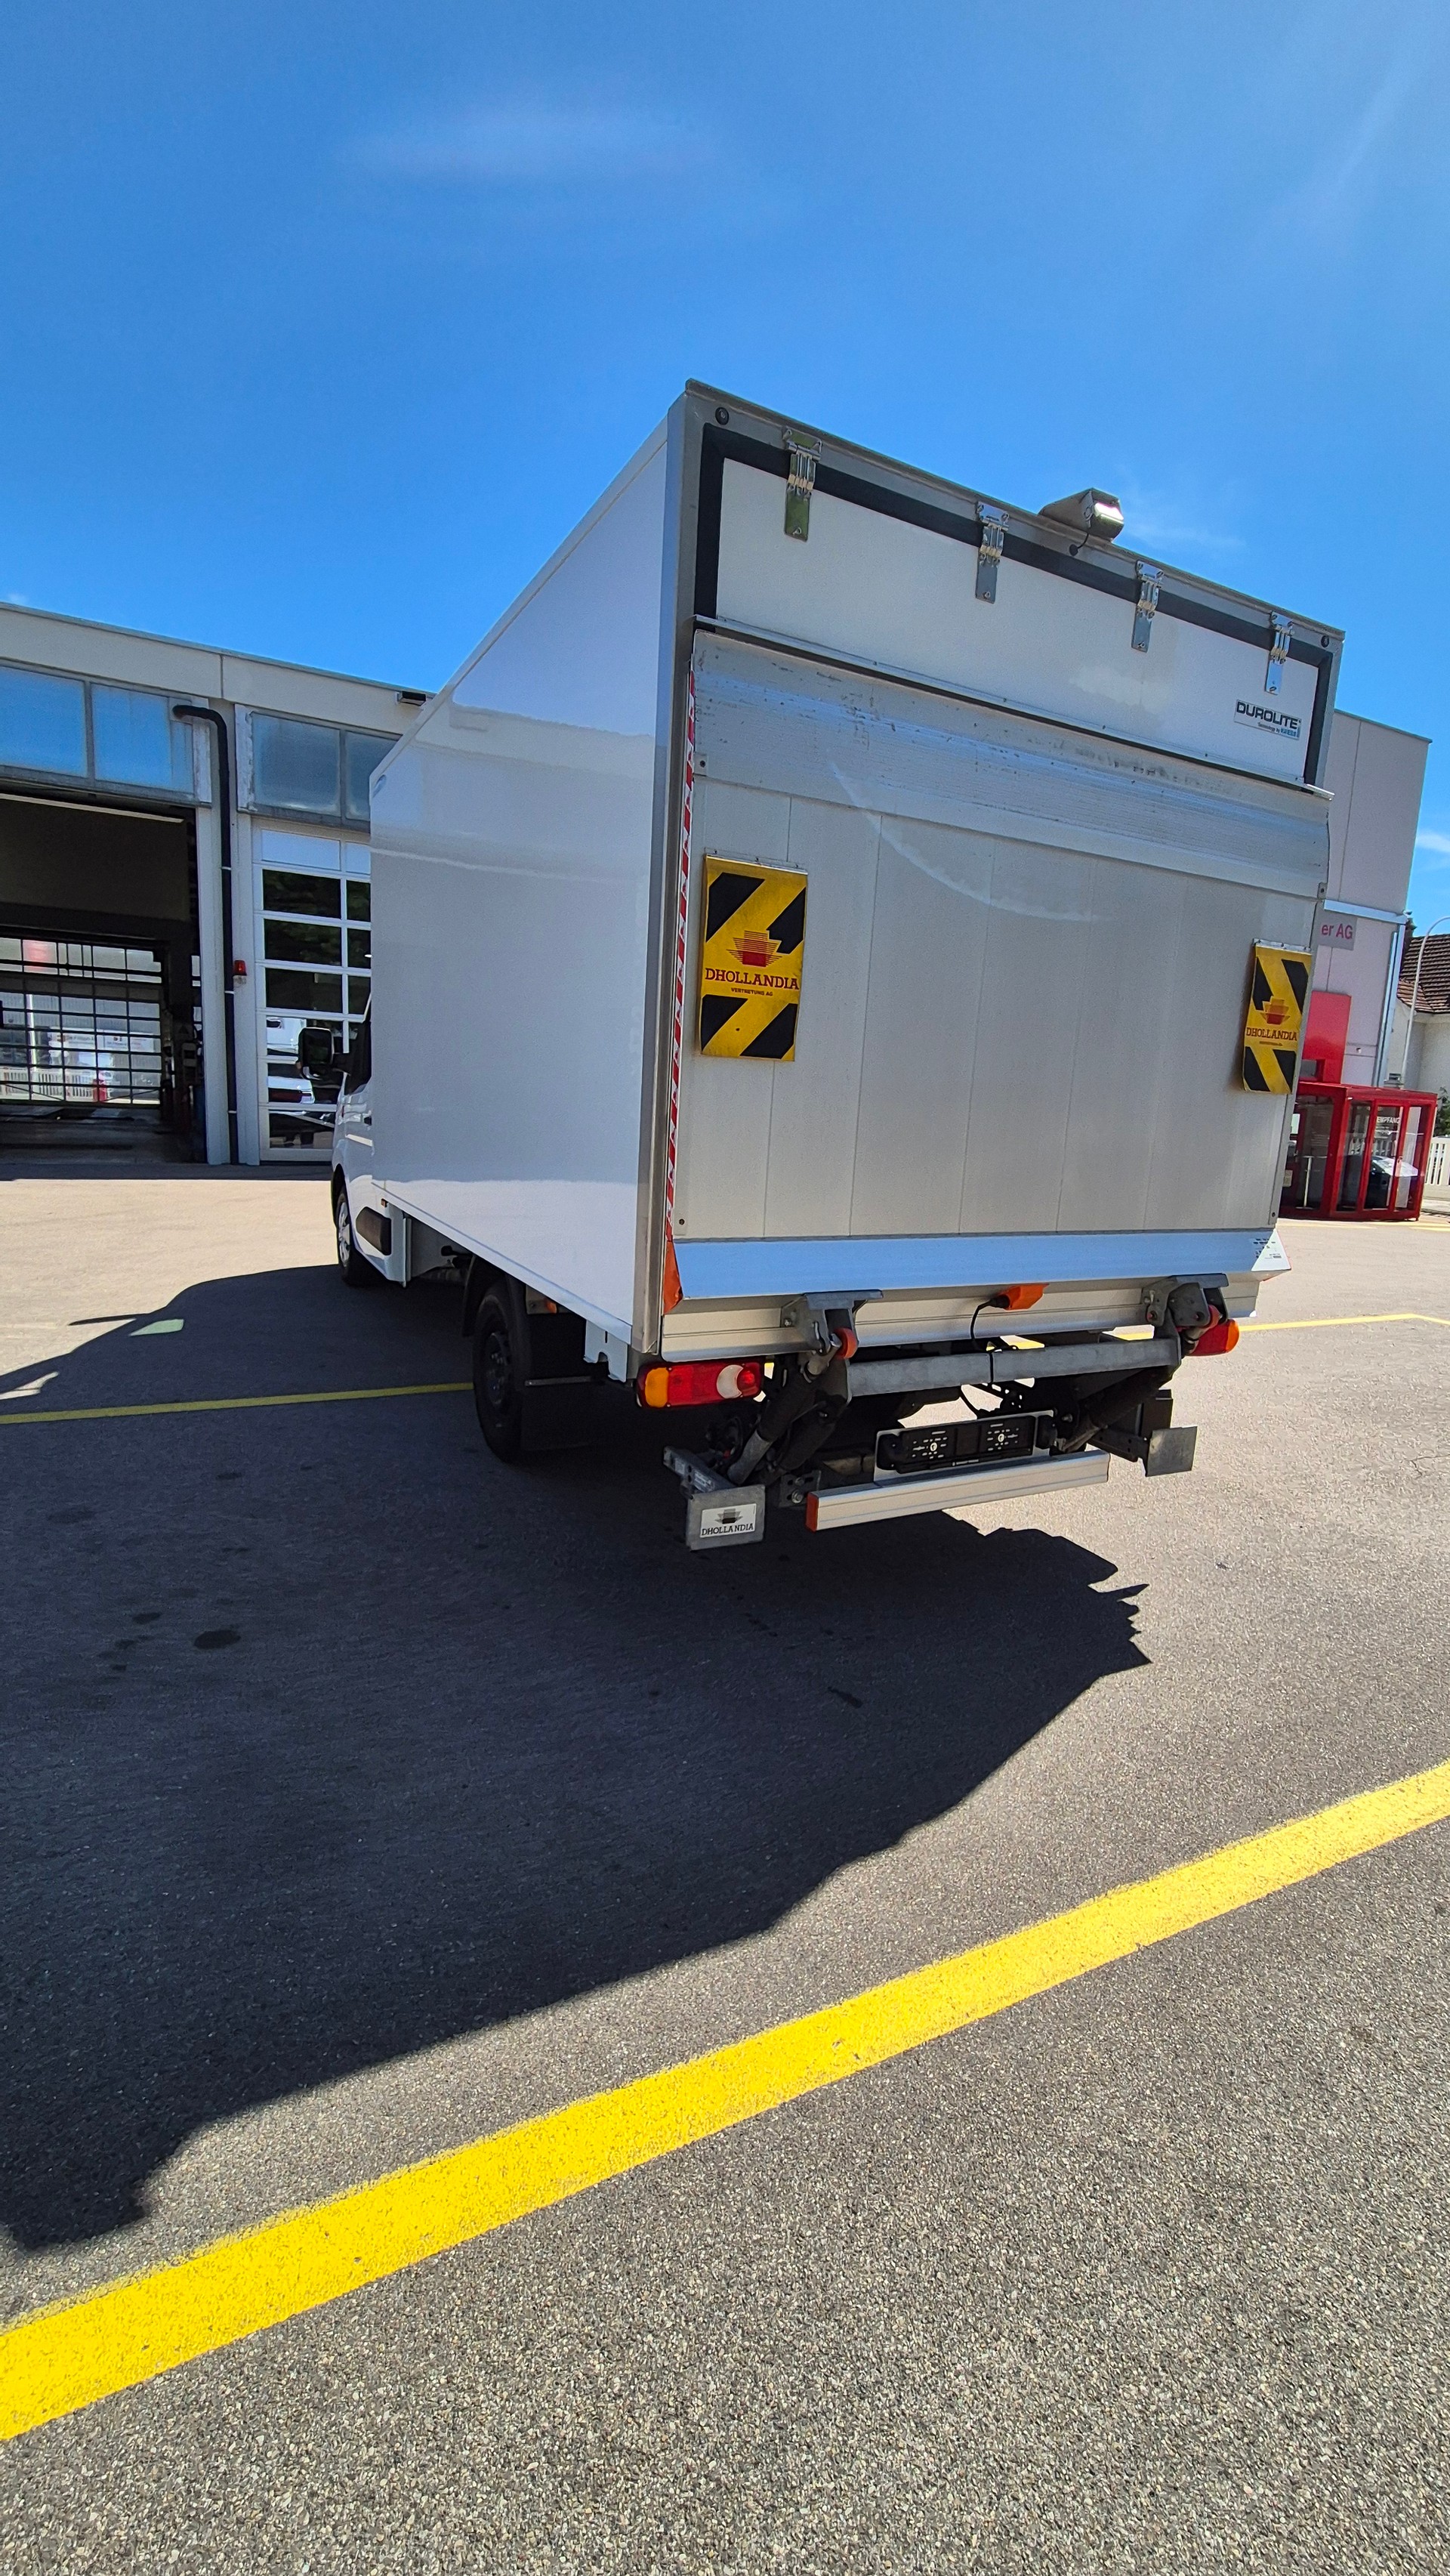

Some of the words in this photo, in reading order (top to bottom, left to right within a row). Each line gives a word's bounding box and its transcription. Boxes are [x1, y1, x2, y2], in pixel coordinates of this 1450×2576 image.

[1236, 701, 1298, 730] DUROLITE
[1336, 923, 1353, 939] AG
[705, 968, 800, 990] DHOLLANDIA
[731, 987, 765, 996] VERTRETUNG
[1246, 1027, 1297, 1041] DHOLLANDIA
[702, 1523, 754, 1536] DHOLLANDIA
